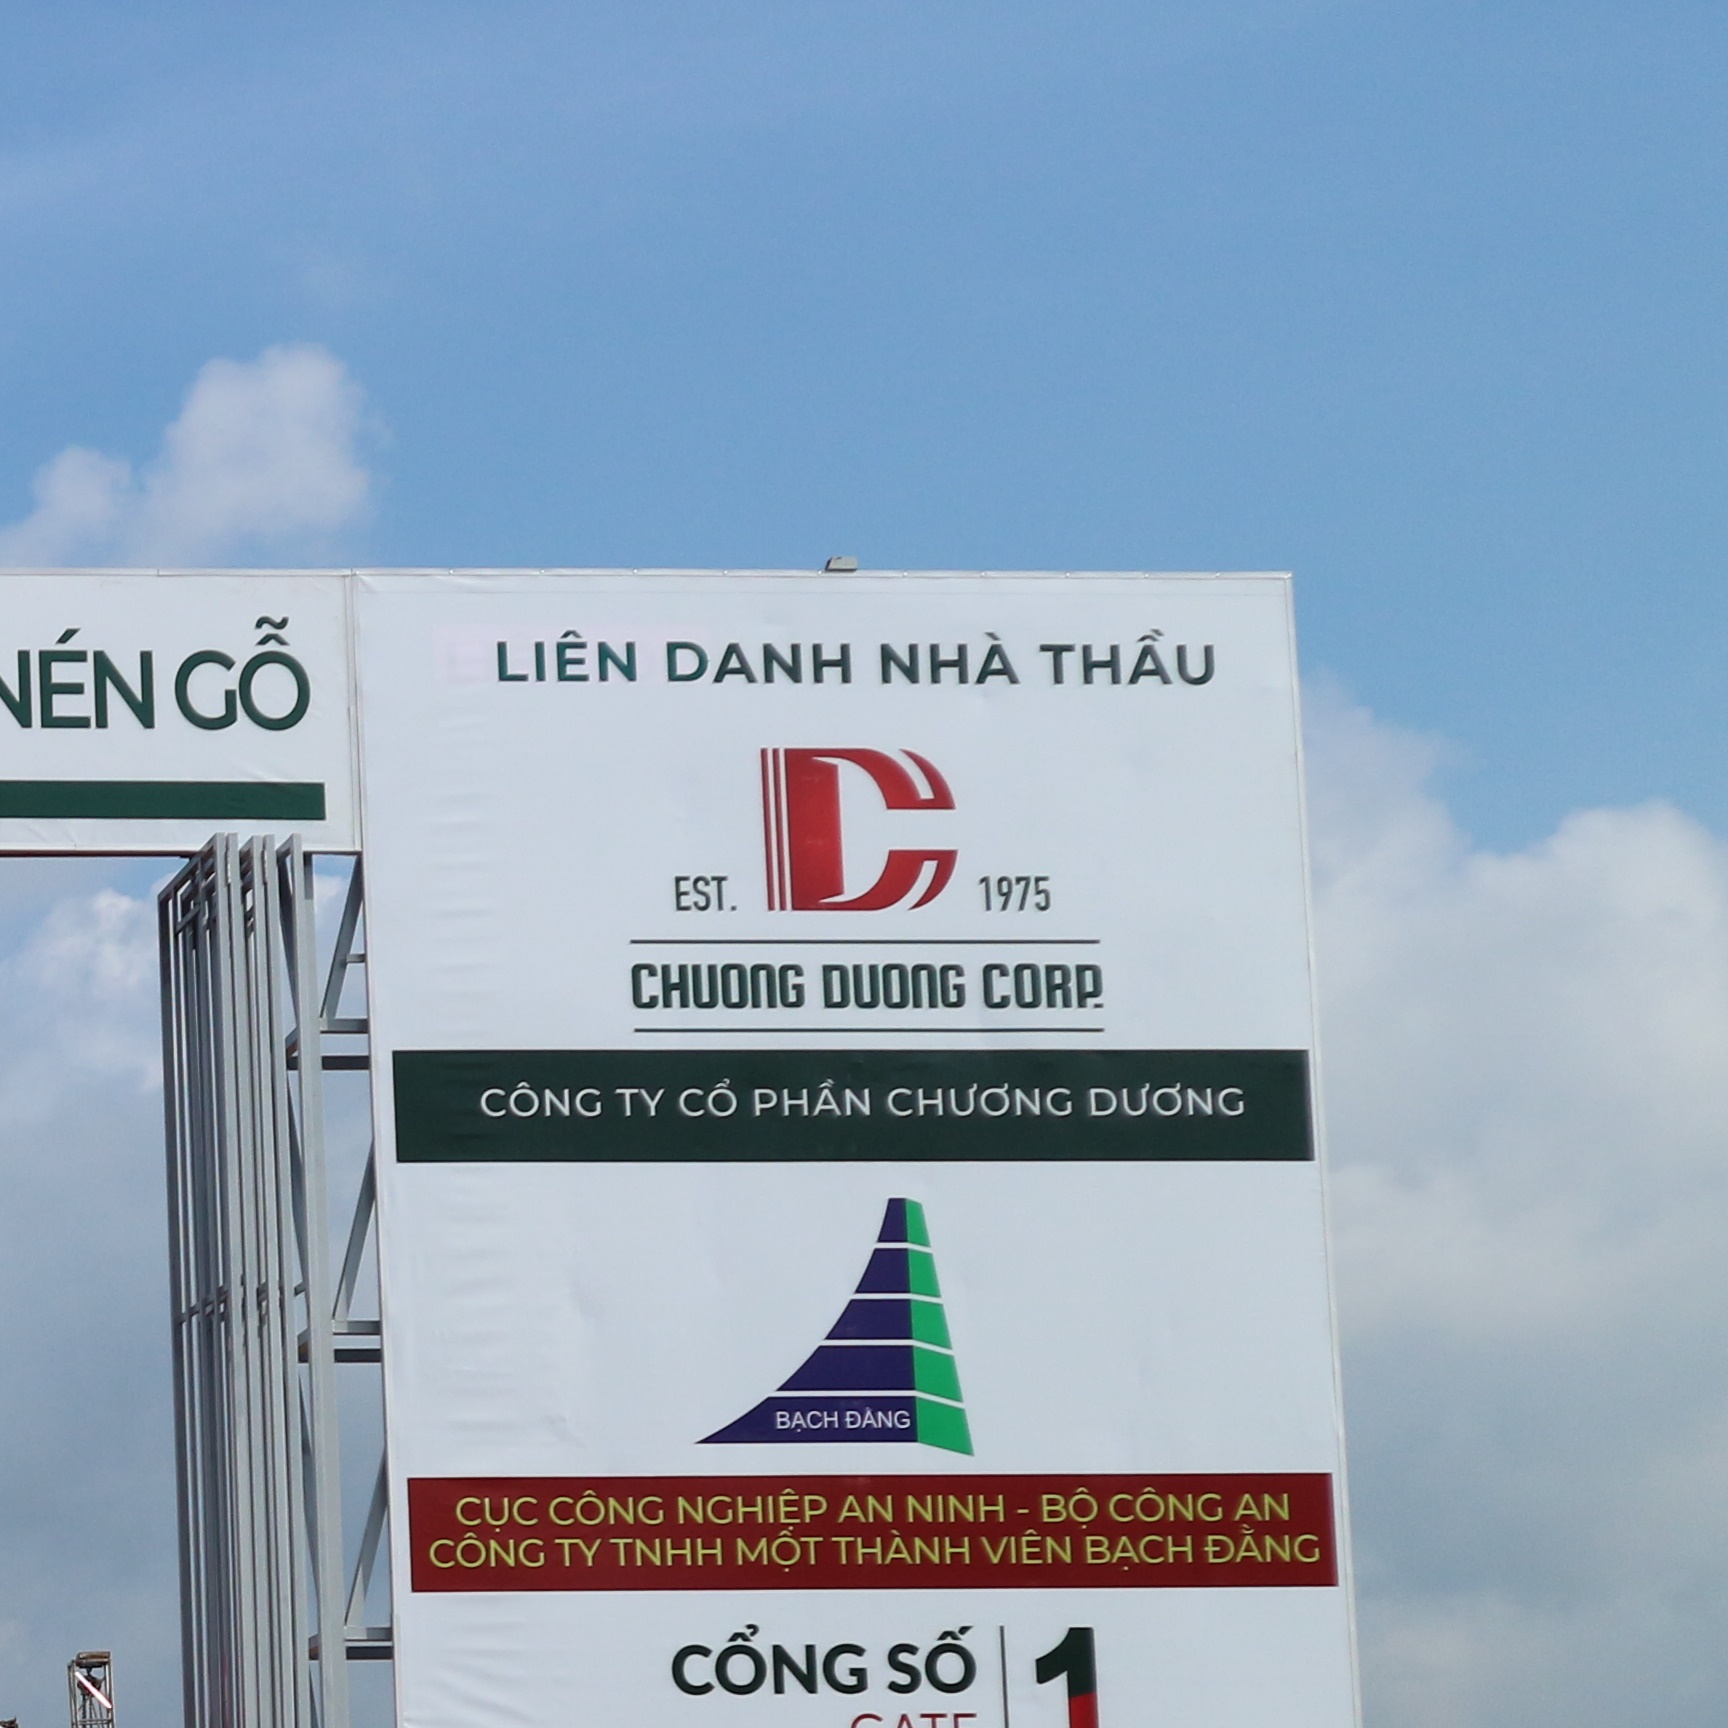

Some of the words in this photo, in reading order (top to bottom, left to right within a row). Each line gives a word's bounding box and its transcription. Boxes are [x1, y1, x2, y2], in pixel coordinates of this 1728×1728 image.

[175, 617, 310, 731] GỖ
[497, 630, 636, 682] LIÊN
[667, 642, 851, 684] DANH
[881, 632, 1020, 684] NHÀ
[1040, 630, 1214, 685] THẦU
[675, 876, 736, 911] EST.
[979, 876, 1050, 911] 1975
[632, 964, 804, 1008] CHUONG
[823, 964, 965, 1008] DUONG
[983, 964, 1102, 1008] CORP.
[776, 1411, 838, 1432] BẠCH
[845, 1407, 910, 1428] ĐẰNG
[672, 1624, 867, 1695] CỔNG
[888, 1626, 976, 1694] SỐ
